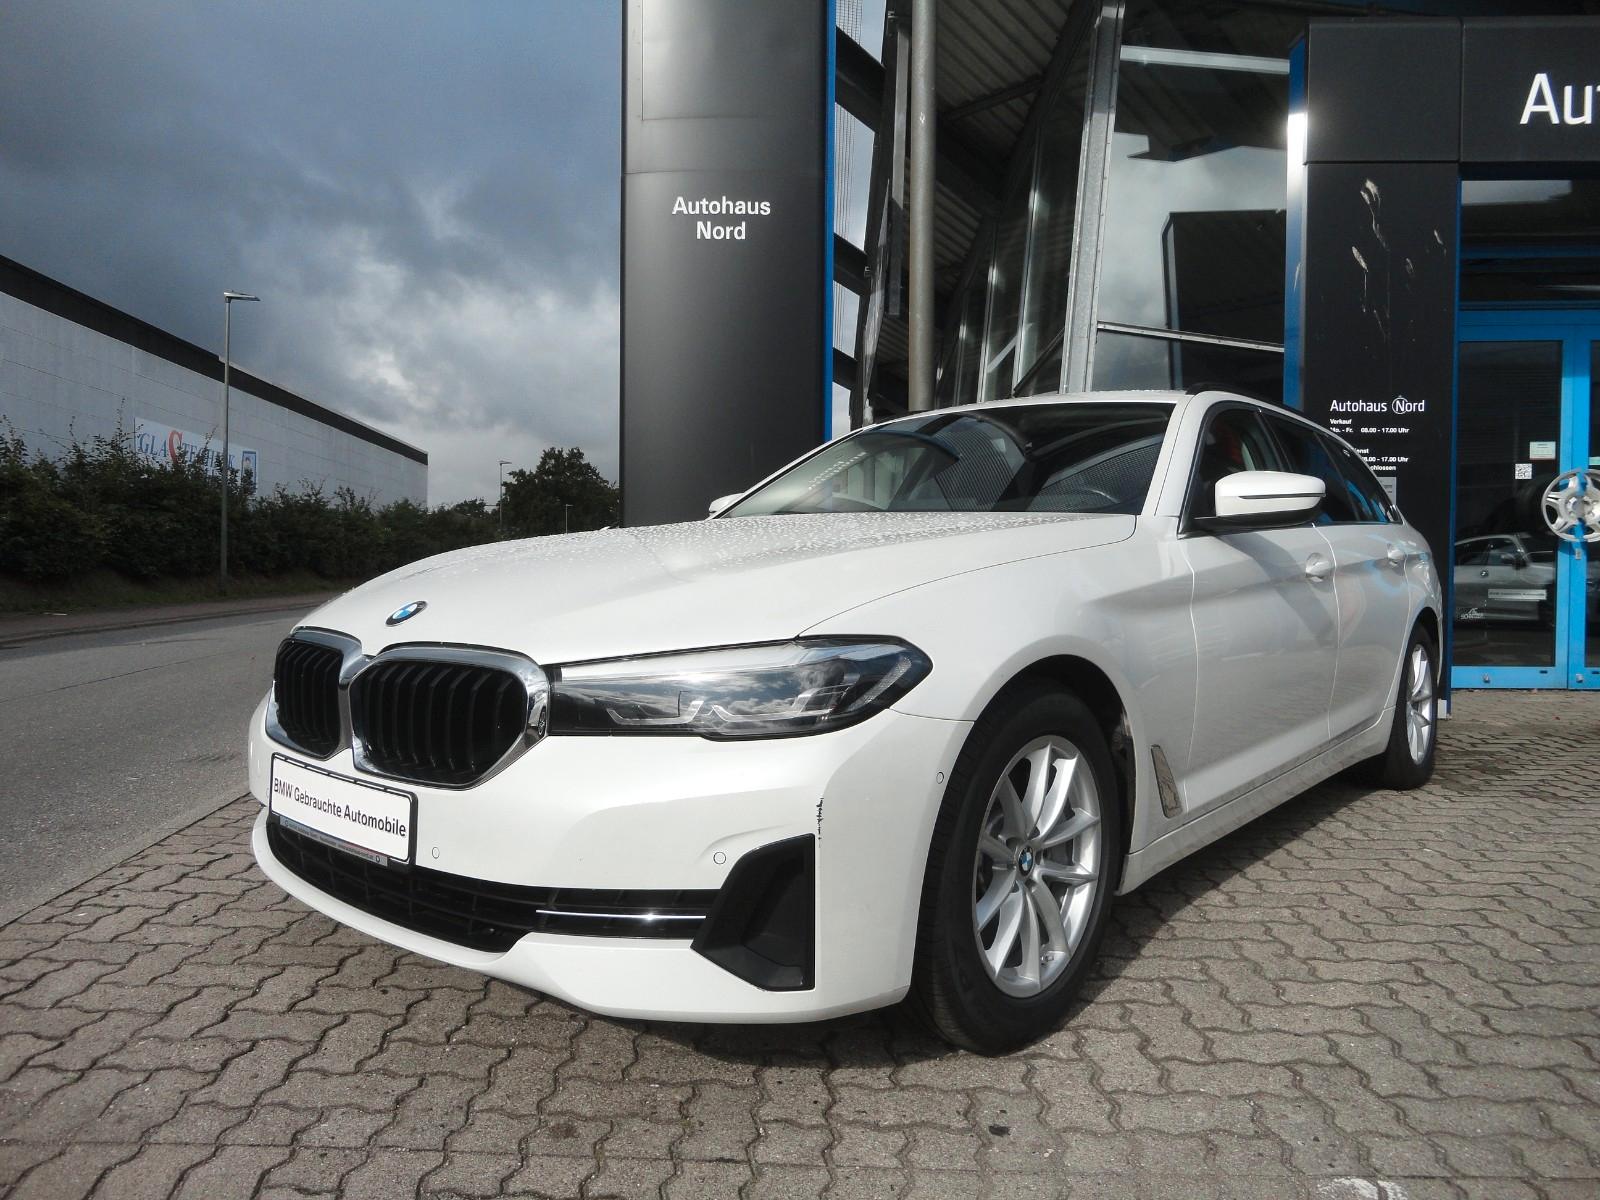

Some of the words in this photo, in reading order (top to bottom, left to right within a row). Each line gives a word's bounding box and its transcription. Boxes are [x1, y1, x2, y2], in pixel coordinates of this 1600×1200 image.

[1519, 72, 1600, 125] Au
[671, 195, 771, 215] Autohaus
[696, 220, 746, 240] Nord
[1329, 399, 1388, 412] Autohaus
[1394, 399, 1425, 412] Nord
[273, 777, 293, 799] BMW
[294, 786, 342, 818] Gebrauchte
[343, 805, 407, 838] Automobile
